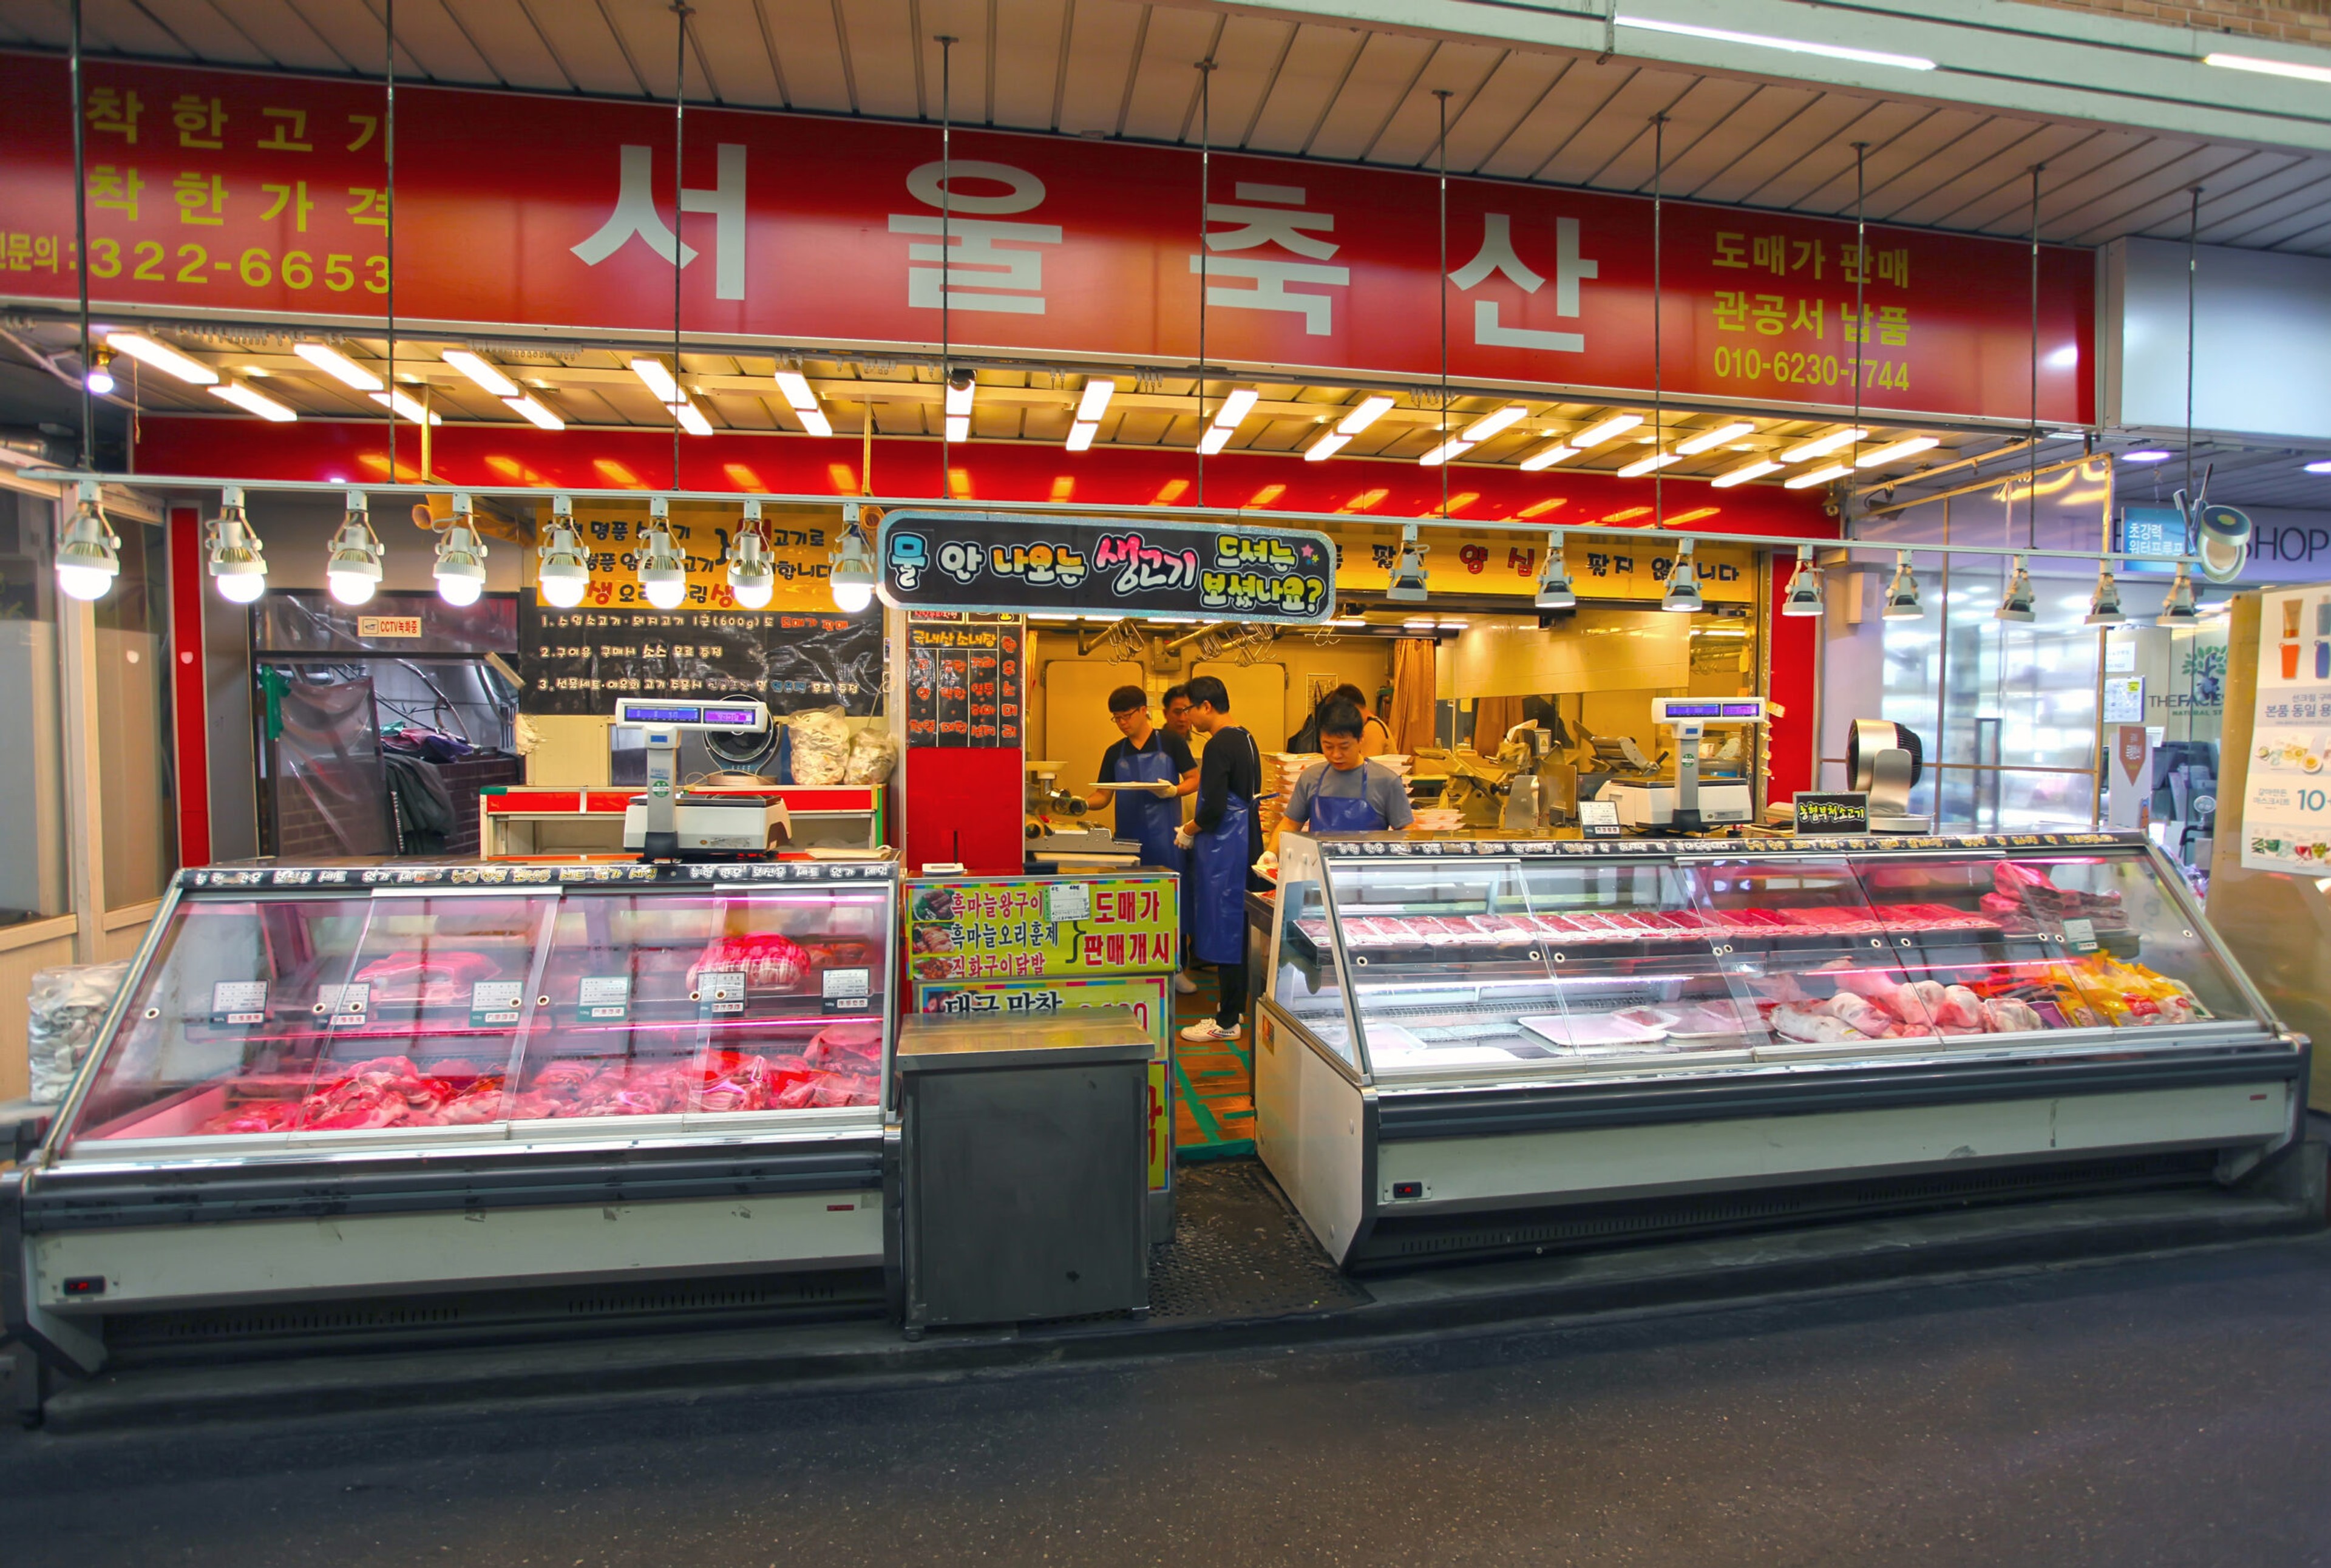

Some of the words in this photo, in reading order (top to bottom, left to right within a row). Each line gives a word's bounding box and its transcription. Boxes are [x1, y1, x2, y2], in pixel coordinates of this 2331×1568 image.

[90, 238, 393, 294] 322-6653
[569, 143, 1598, 353] 서울축산
[1712, 232, 1826, 280] 도매가
[1840, 243, 1909, 288] 판매
[1712, 291, 1824, 339] 관공서
[1841, 302, 1911, 346] 납품
[1714, 346, 1910, 392] 010-6230-7744
[591, 521, 628, 541] 명품
[2128, 523, 2162, 540] 초강력
[2245, 524, 2330, 563] HOP
[887, 532, 931, 591] 물
[989, 541, 1088, 588] 나오는
[1093, 532, 1199, 596] 생고기
[1651, 557, 1740, 582] 않니다
[2148, 694, 2224, 708] THEFACE
[2265, 705, 2289, 718] 본품
[2292, 704, 2316, 718] 동일
[951, 891, 1043, 920] 흑마늘왕구이
[1094, 890, 1160, 924] 도매가
[950, 921, 1059, 951] 흑마늘오리훈제
[1084, 932, 1170, 966] 판매개시
